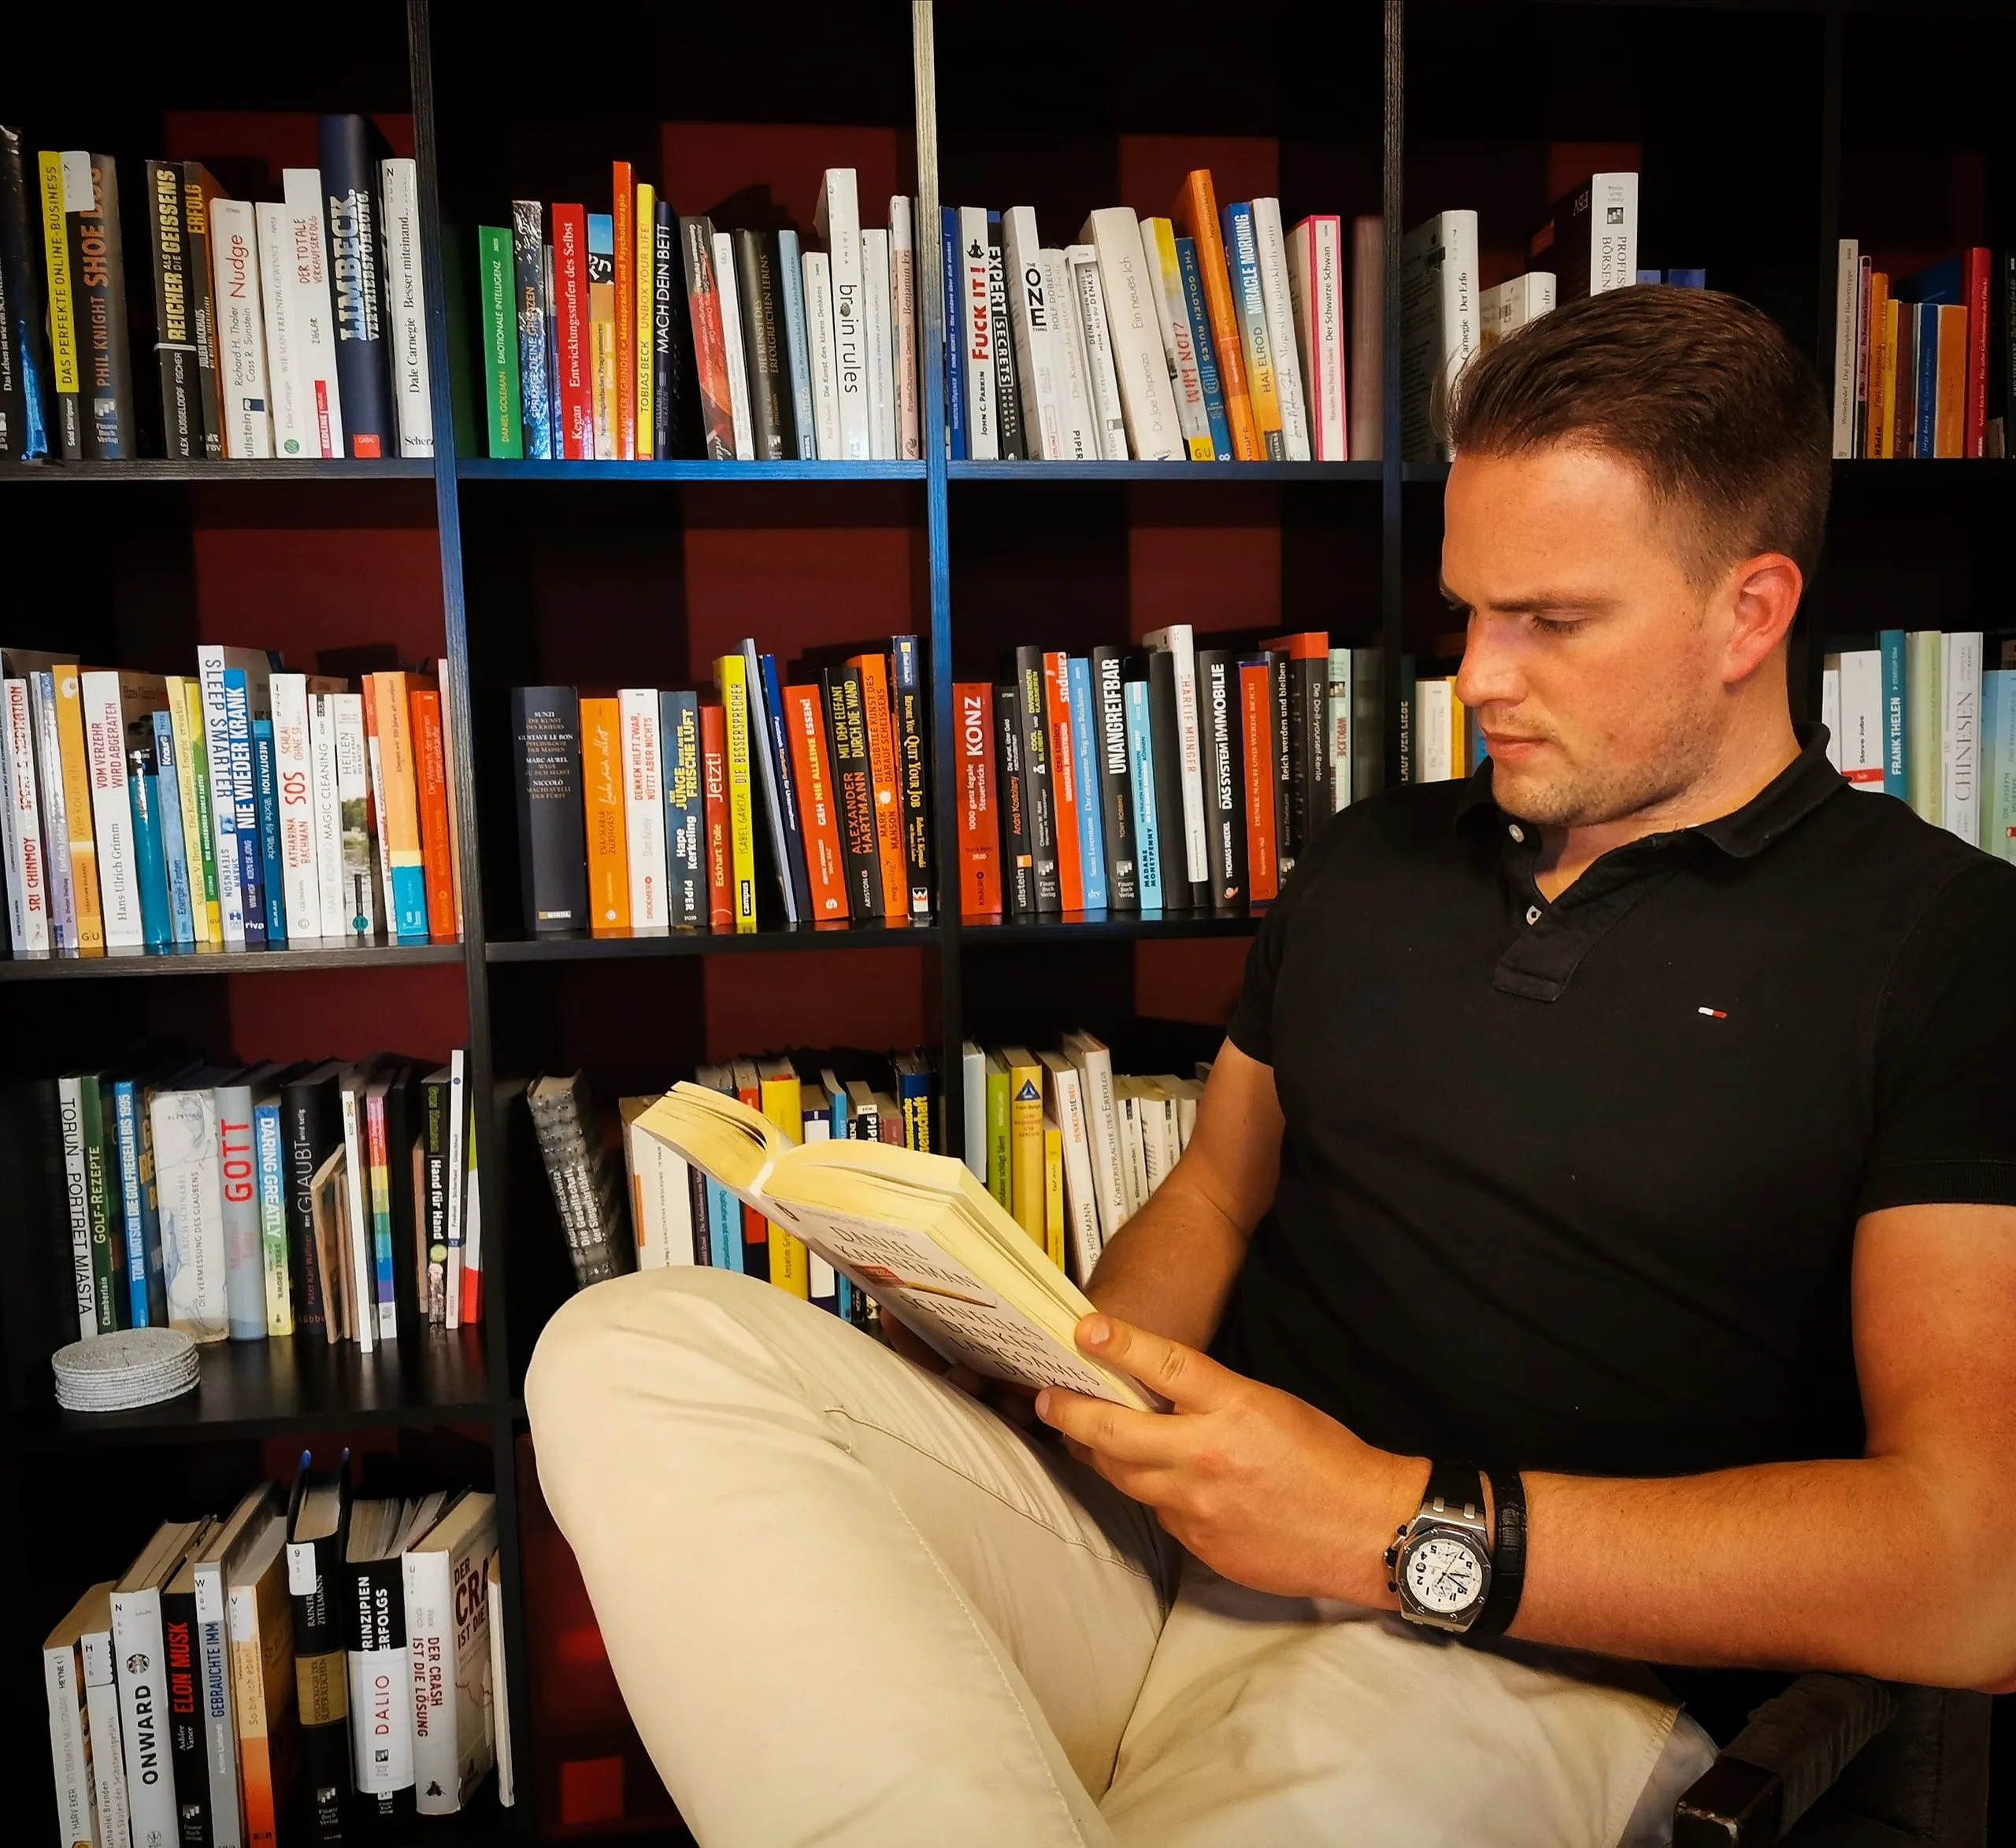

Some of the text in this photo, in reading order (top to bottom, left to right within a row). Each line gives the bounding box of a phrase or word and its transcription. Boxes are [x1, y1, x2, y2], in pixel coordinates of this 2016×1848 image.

[156, 169, 181, 254] GEISSENS
[184, 183, 206, 234] ERFOLG
[80, 225, 108, 287] SHOE
[225, 235, 249, 298] Nudge
[293, 218, 310, 283] DER TOTALE
[330, 188, 368, 340] LIMBECK.
[640, 224, 649, 256] LIFE!
[1184, 250, 1194, 271] THE
[1235, 214, 1263, 315] MIRACLE MORNING
[46, 167, 72, 383] DAS PERFEKTE ONLINE-BUSINESS
[656, 224, 670, 354] MACH DEIN BETT
[1188, 276, 1201, 320] GOLDEN
[91, 296, 108, 350] KNIGHT
[163, 272, 187, 340] REICHER
[563, 222, 584, 439] Kegan Entwicklungsstufen des Selbst
[640, 293, 649, 328] UNBOX
[989, 246, 1010, 382] EXPERT SECRETS
[1324, 283, 1332, 324] Schwarze
[229, 306, 243, 387] Richard H. Thaler
[640, 341, 649, 369] BECK
[972, 306, 988, 360] FUCK
[1197, 326, 1210, 361] RULES
[1253, 327, 1272, 392] HAL ELROD
[95, 355, 110, 387] PHIL
[866, 675, 875, 693] DES
[1278, 662, 1287, 697] bleiben
[206, 659, 232, 797] SLEEP SMARTER
[731, 683, 747, 783] DIE BESSERSPRECHER
[800, 699, 815, 735] ESSEN!
[832, 686, 850, 759] MIT DEM ELEFANT
[845, 680, 865, 757] DURCH DIE WAND
[869, 695, 877, 725] KUNST
[877, 688, 892, 782] DARAUF SCHEISSENS
[964, 696, 983, 756] KONZ
[1101, 659, 1127, 774] UNANGREIFBAR
[1890, 697, 1901, 776] FRANK THELEN
[91, 722, 108, 789] VOM VERZEHR
[106, 702, 123, 788] WIRD ABGERATEN
[224, 687, 256, 828] NIE WIEDER KRANK
[340, 732, 352, 774] HEILEN
[631, 713, 643, 800] DENKEN HILFT ZWAR,
[644, 717, 655, 800] NÜTZT ABER NICHTS
[682, 709, 698, 797] FRISCHE LUFT
[807, 738, 821, 780] ALLEINE
[872, 728, 882, 767] SUBTILE
[1280, 755, 1290, 780] Reich
[284, 772, 306, 805] SOS
[318, 743, 333, 839] MAGIC CLEANING
[674, 768, 687, 810] JUNGE
[706, 752, 724, 802] Jetzt!
[813, 783, 823, 801] NIE
[966, 764, 976, 788] legale
[968, 790, 976, 809] ganz
[976, 764, 986, 811] Steuertricks
[815, 803, 827, 825] GEH
[843, 772, 862, 854] ALEXANDER
[854, 772, 873, 854] HARTMANN
[878, 812, 887, 837] MARK
[888, 811, 899, 850] MANSON
[286, 818, 298, 868] KATHARINA
[676, 828, 687, 857] Hape
[685, 816, 699, 869] Kerkeling
[713, 824, 724, 887] Eckhart Tolle
[24, 837, 41, 911] SRI CHINMOY
[684, 880, 694, 910] PIPER
[741, 882, 750, 914] campus
[1016, 869, 1027, 907] ullstein
[220, 1118, 252, 1202] GOTT
[260, 1118, 282, 1238] DARING GREATLY
[294, 1140, 313, 1213] GLAUBT
[62, 1097, 92, 1314] TORUŃ PORTRET MIASTA
[89, 1146, 106, 1243] GOLF-REZEPTE
[119, 1094, 144, 1281] TOM WATSON DIE GOLFREGELN BIS 1995
[431, 1159, 443, 1239] Hand für Hand
[576, 1228, 590, 1246] Die
[829, 1225, 929, 1261] DANIEL
[834, 1243, 984, 1291] KAHNEMAN
[99, 1276, 111, 1326] Chamberlain
[899, 1294, 1044, 1340] SCHNELLES
[948, 1337, 1099, 1386] LANGSAMES
[315, 1575, 326, 1625] ZITELMANN
[57, 1665, 66, 1689] HEYNE
[168, 1622, 195, 1713] ELON MUSK
[413, 1638, 431, 1737] IST DIE LÖSUNG
[428, 1637, 443, 1705] DER CRASH
[375, 1675, 390, 1735] DALIO
[135, 1685, 159, 1784] ONWARD
[68, 1788, 78, 1807] EKER
[70, 1809, 80, 1828] HARV
